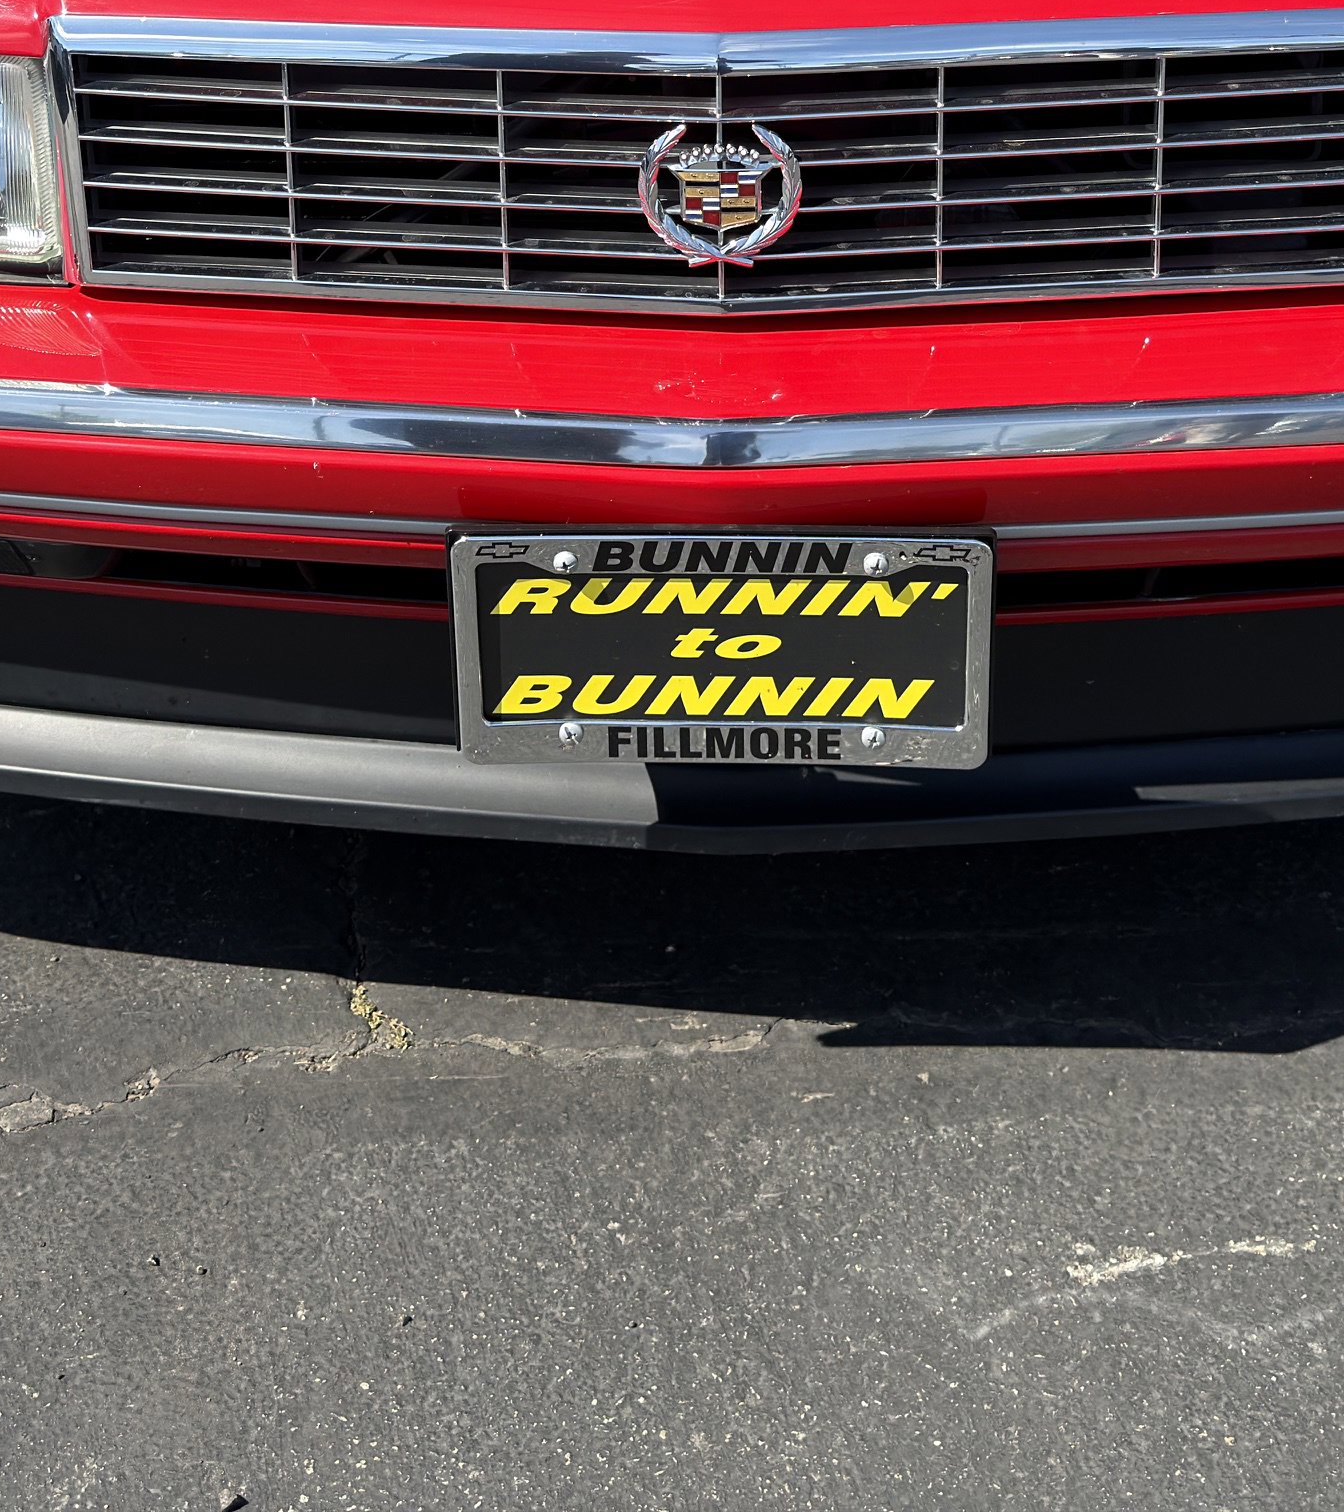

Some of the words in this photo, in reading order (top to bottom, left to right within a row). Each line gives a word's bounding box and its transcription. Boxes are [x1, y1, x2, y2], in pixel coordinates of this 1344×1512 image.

[592, 541, 854, 573] BUNNIN
[490, 577, 960, 618] RUNNIN'
[669, 627, 783, 659] to
[491, 674, 936, 719] BUNNIN
[607, 725, 842, 760] FILLMORE
